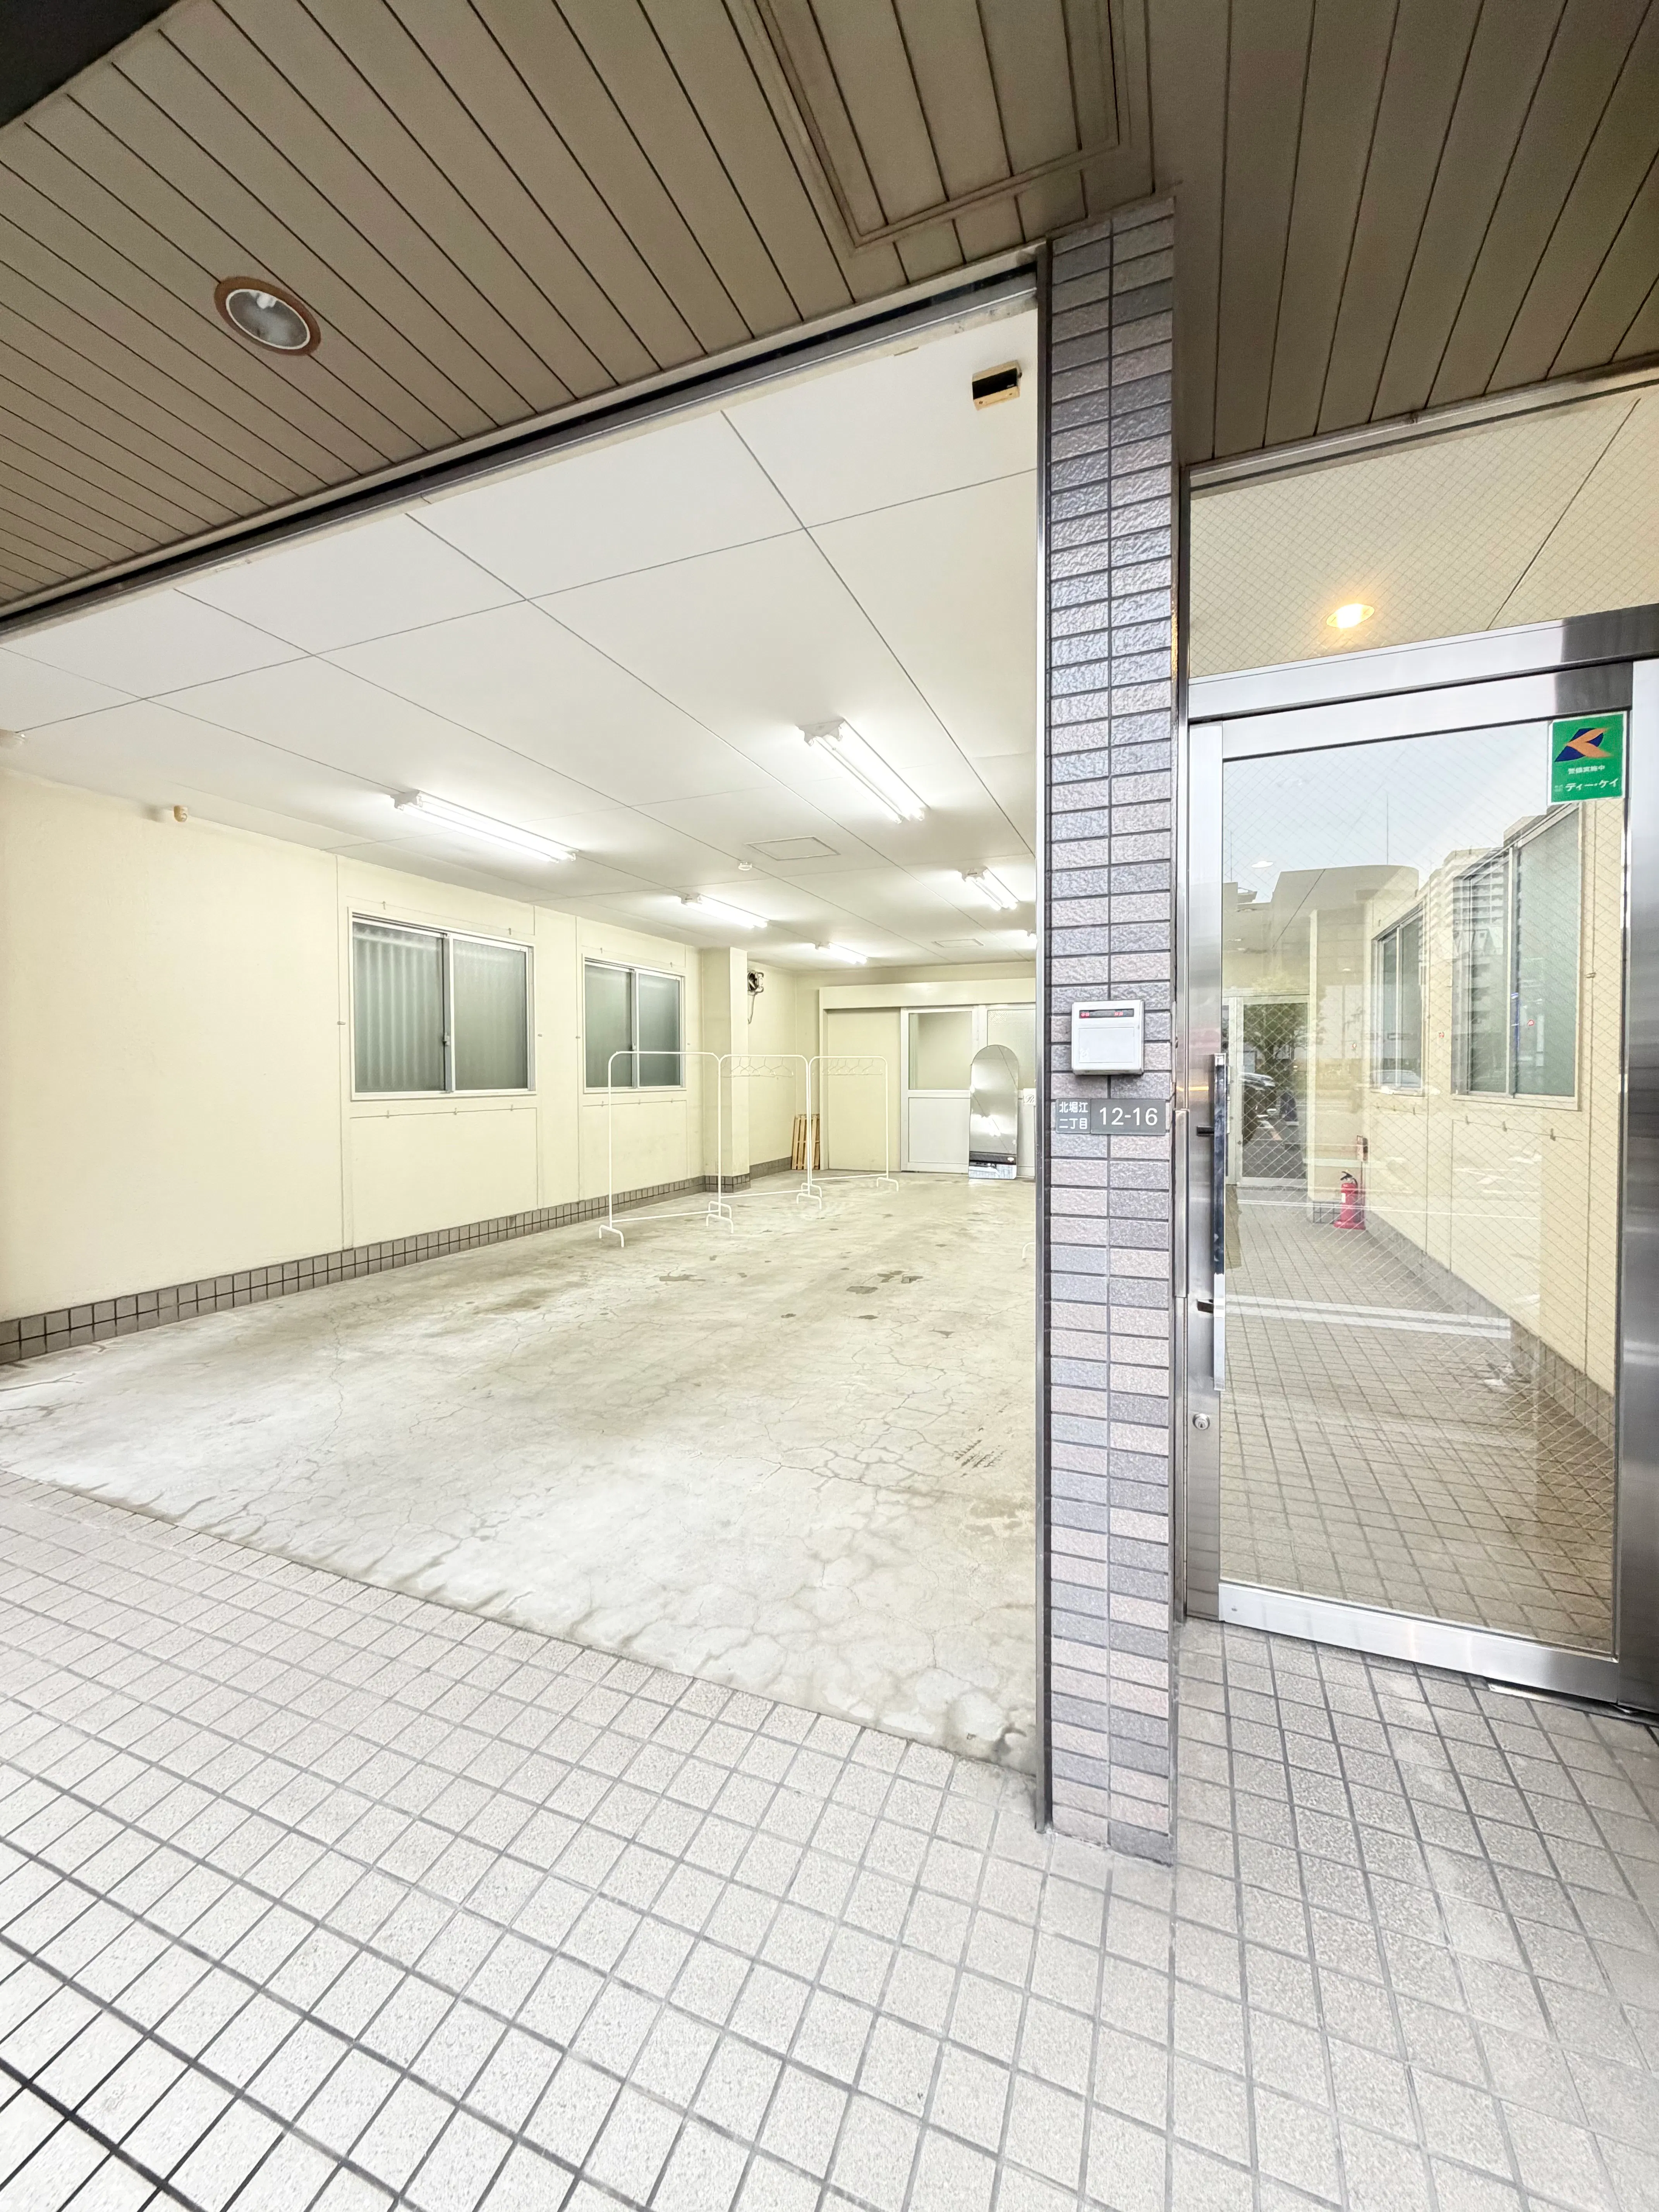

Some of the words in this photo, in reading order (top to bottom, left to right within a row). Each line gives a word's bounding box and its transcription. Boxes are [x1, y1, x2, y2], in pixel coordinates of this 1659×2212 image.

[1059, 1101, 1088, 1113] 北堀江
[1099, 1107, 1158, 1126] 12-16
[1059, 1118, 1087, 1129] 二丁目
